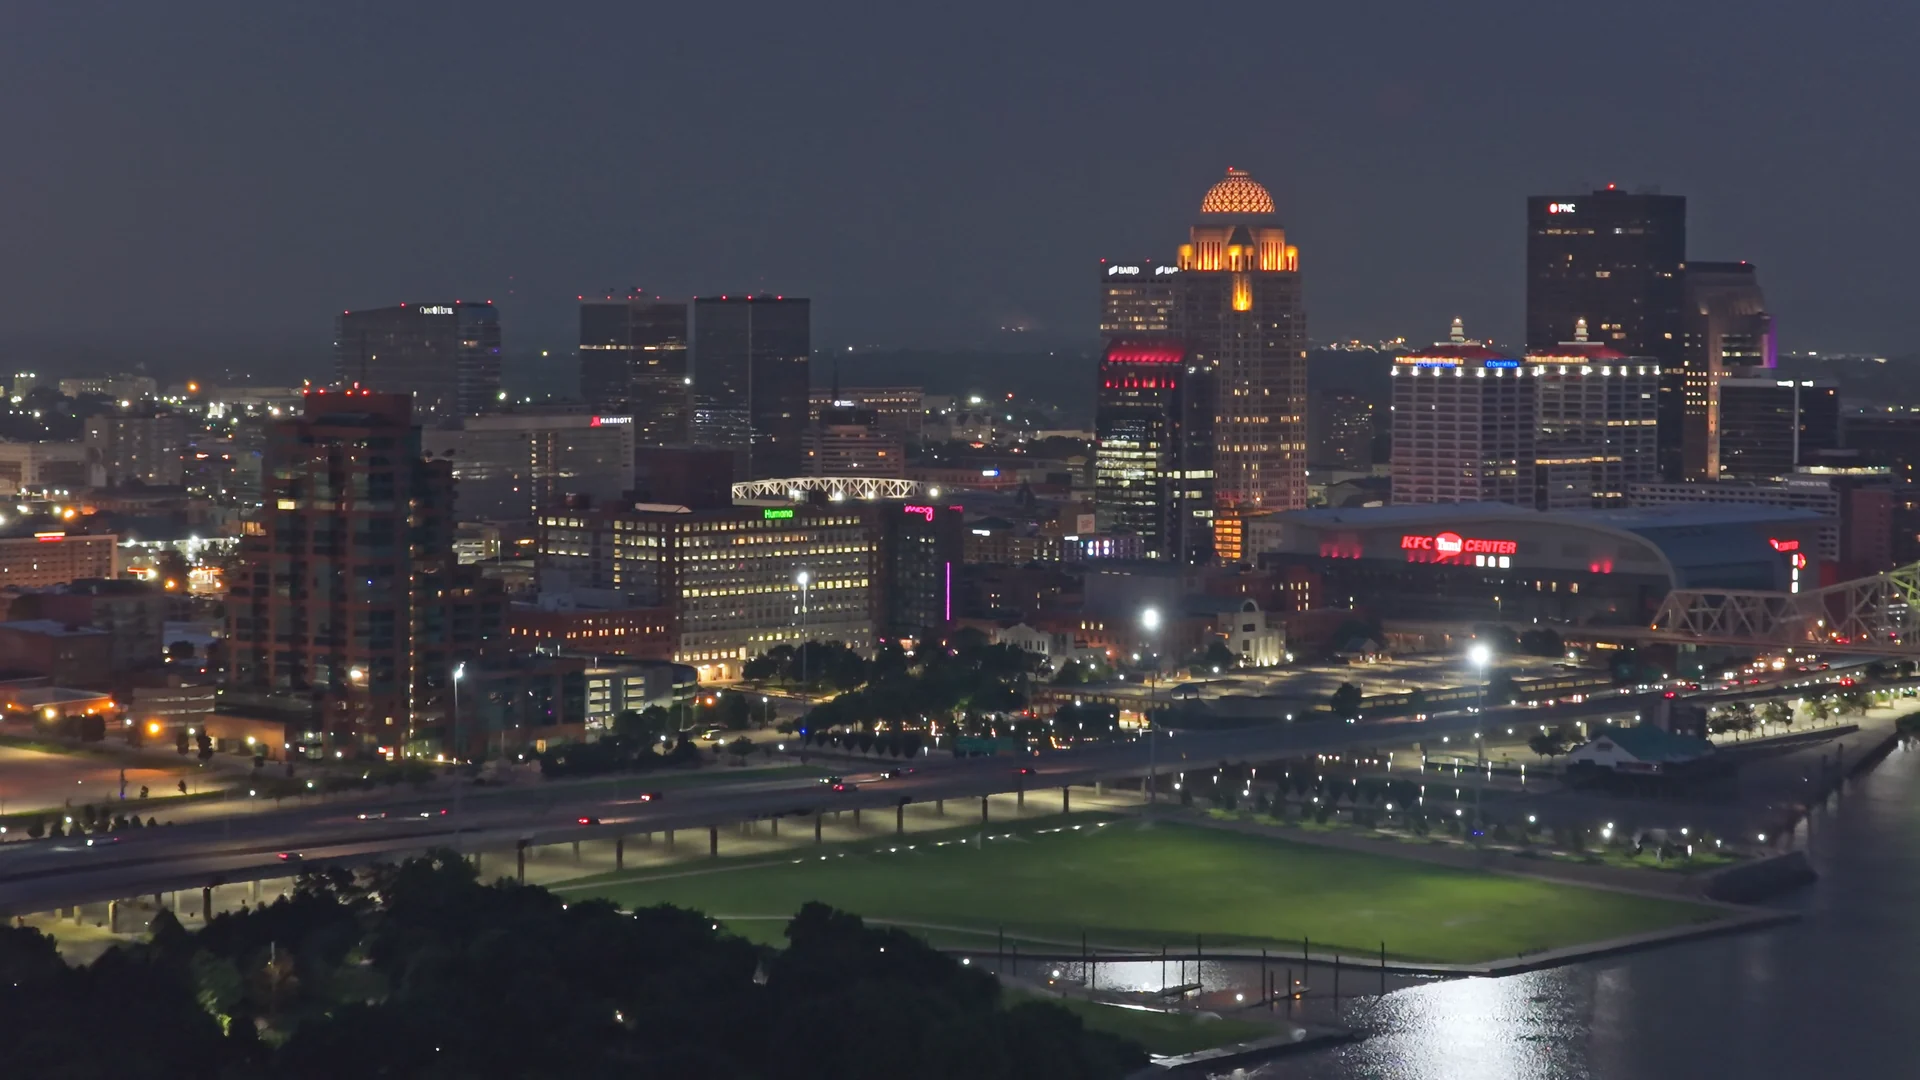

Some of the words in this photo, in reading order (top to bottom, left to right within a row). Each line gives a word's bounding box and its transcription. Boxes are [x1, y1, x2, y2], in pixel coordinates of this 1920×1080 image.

[1558, 203, 1576, 213] PNC
[1118, 266, 1140, 275] BAIRD
[764, 509, 793, 519] Humana
[1401, 536, 1432, 549] KFC
[1436, 537, 1462, 552] Yum!
[1465, 539, 1517, 554] CENTER
